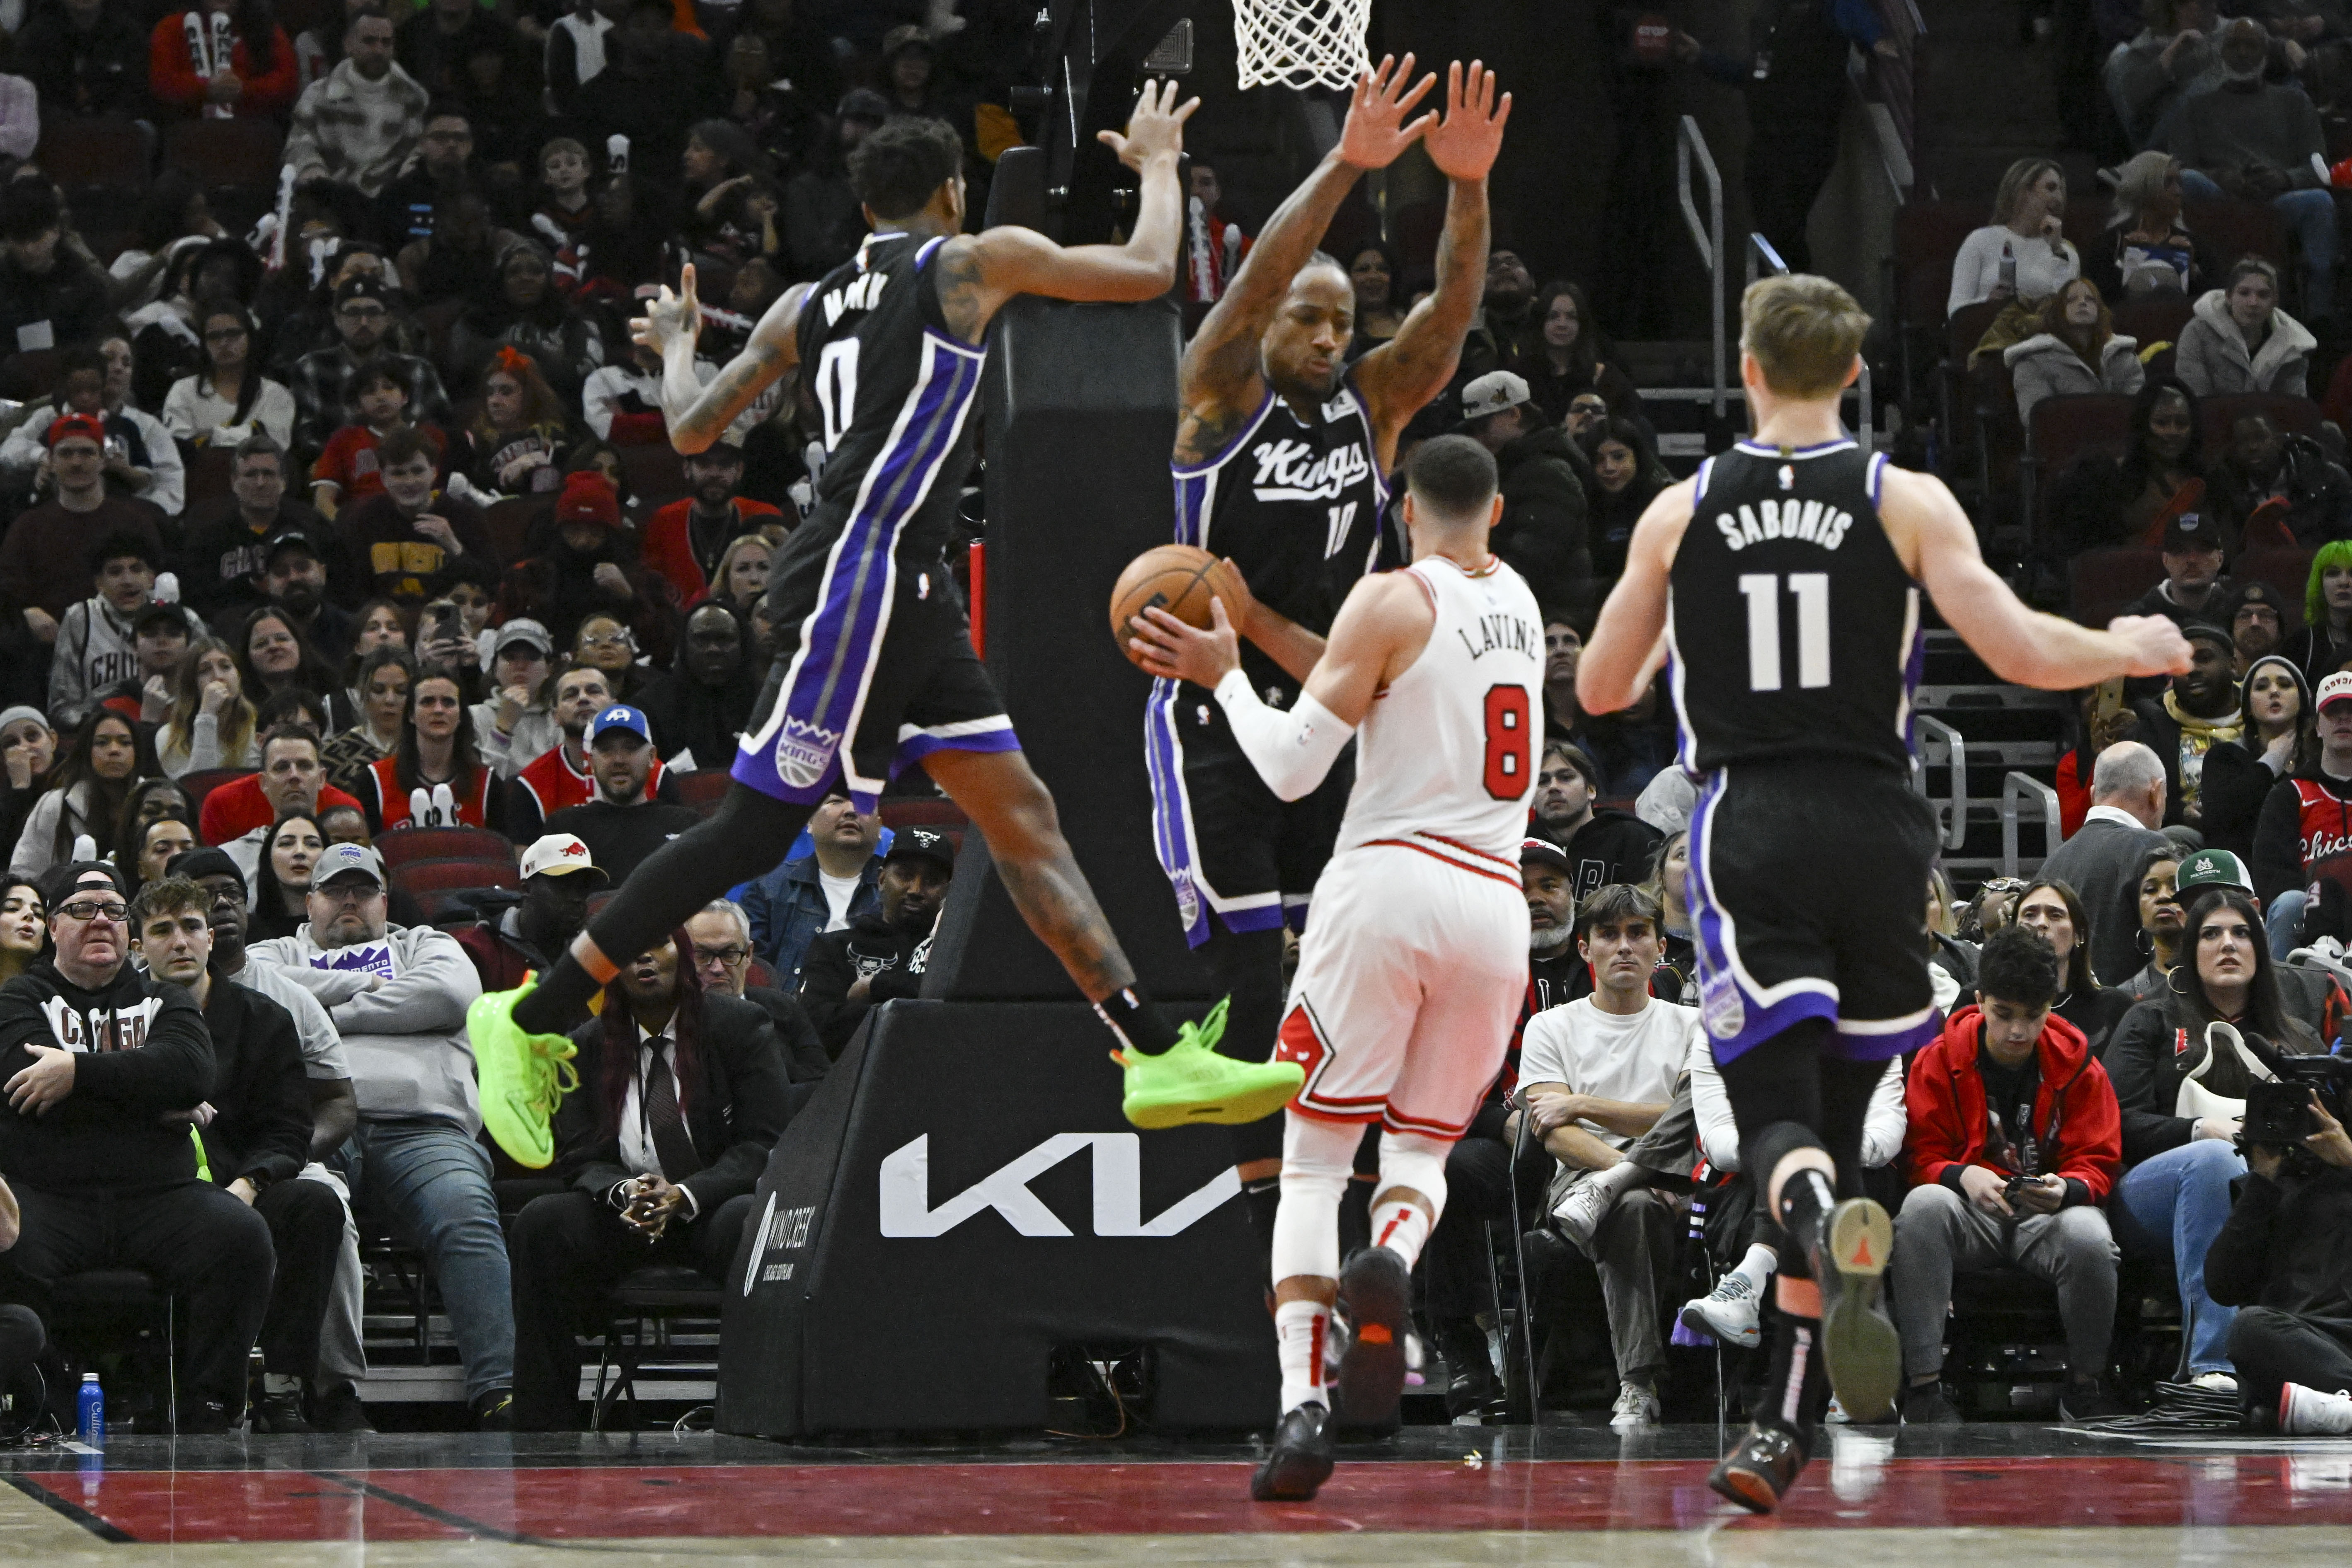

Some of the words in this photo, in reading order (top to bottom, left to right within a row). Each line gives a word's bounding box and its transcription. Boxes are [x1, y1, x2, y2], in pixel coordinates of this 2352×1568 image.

[815, 337, 860, 453] 0
[1252, 438, 1368, 502] Kings
[1716, 499, 1853, 551] SABONIS
[1458, 614, 1536, 661] LAVINE
[1739, 573, 1831, 691] 11
[1483, 683, 1530, 800] 8
[767, 1209, 792, 1251] WIND
[786, 1205, 816, 1249] CREEK
